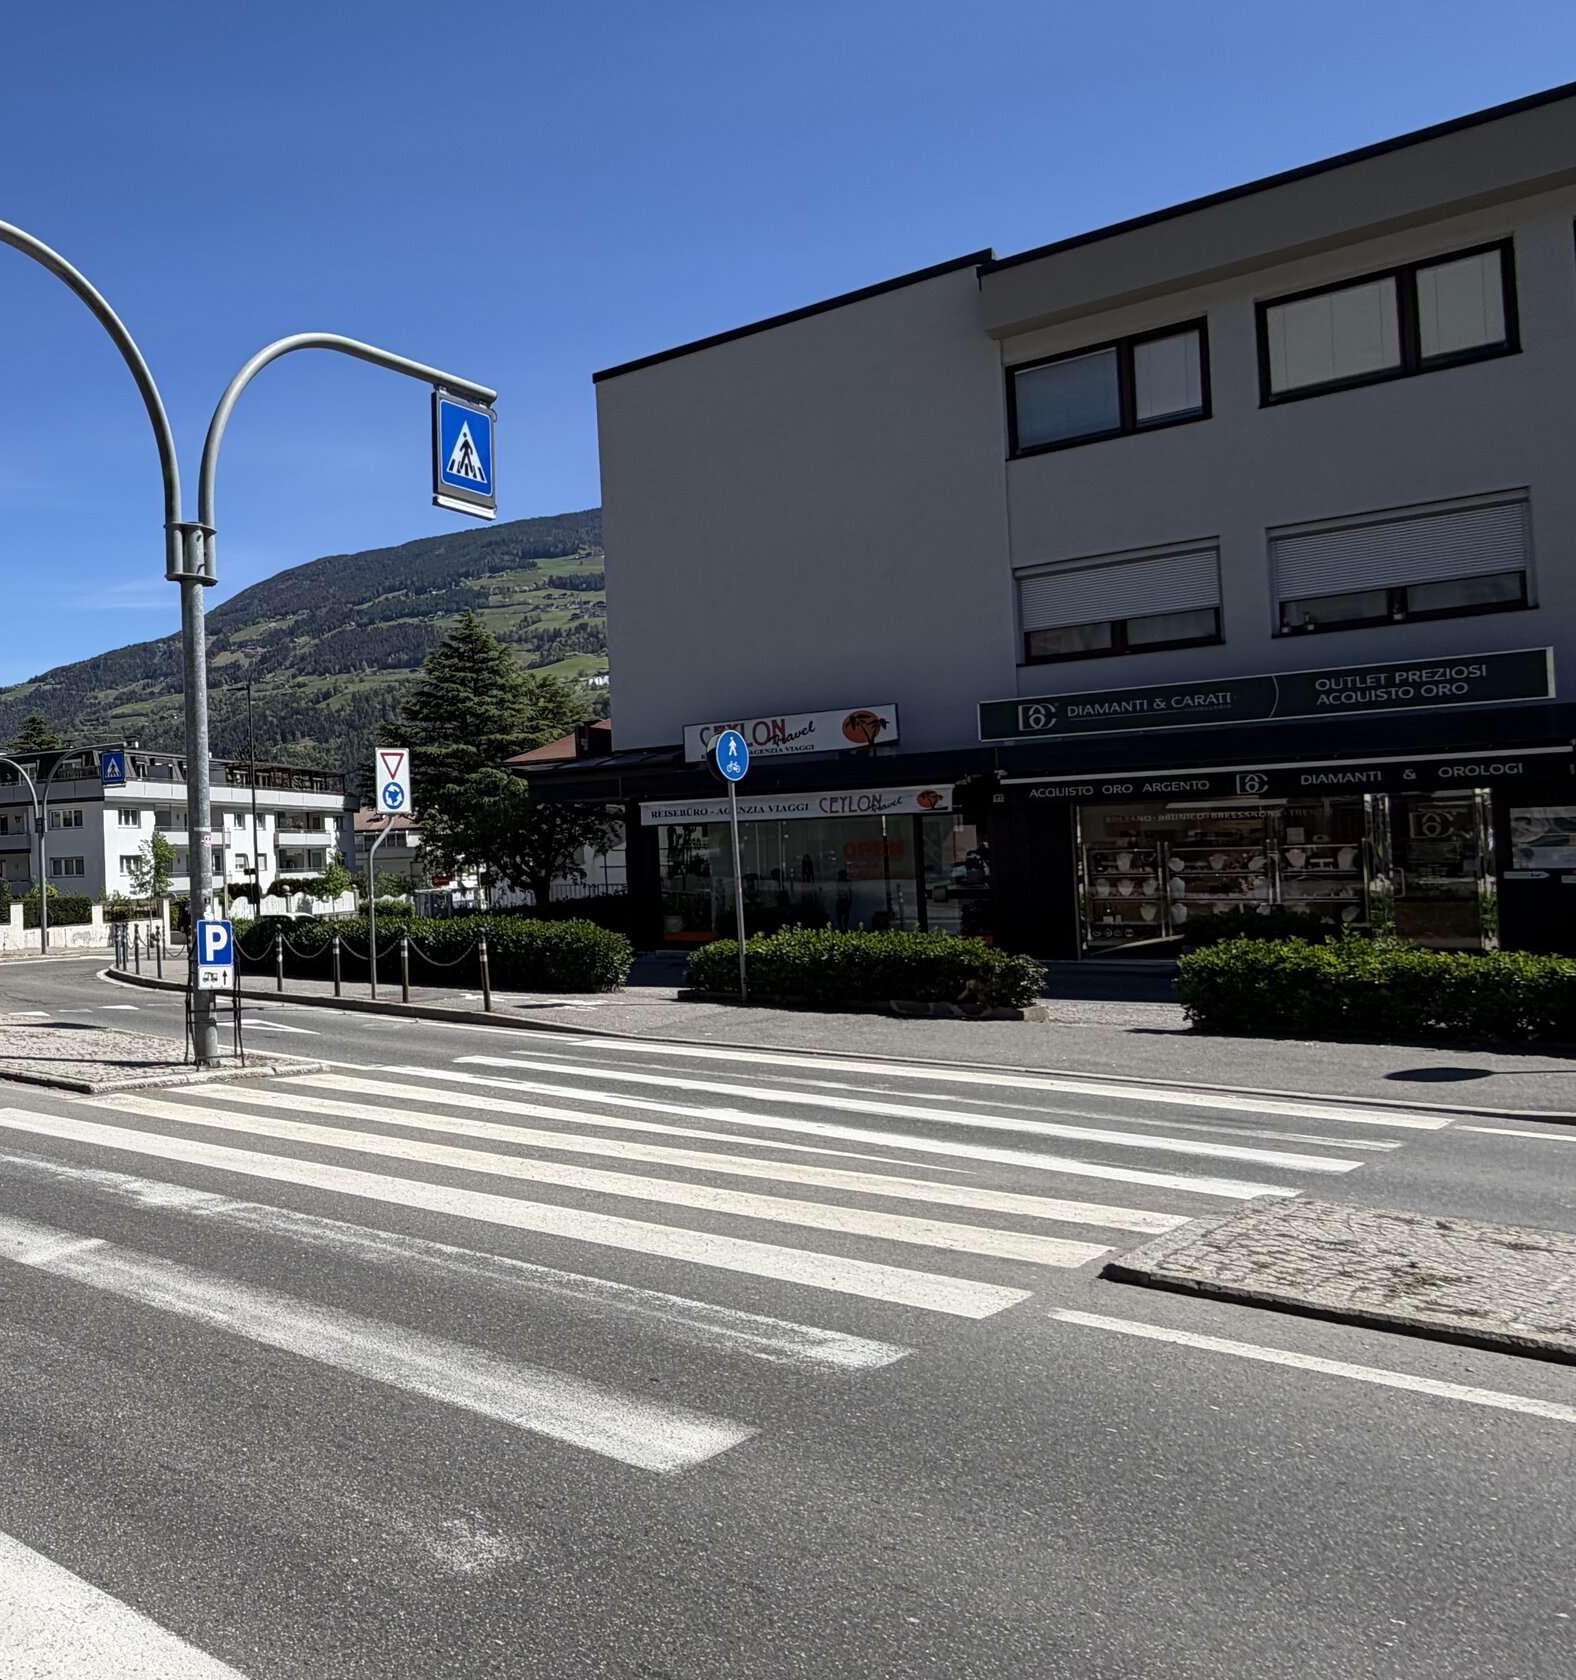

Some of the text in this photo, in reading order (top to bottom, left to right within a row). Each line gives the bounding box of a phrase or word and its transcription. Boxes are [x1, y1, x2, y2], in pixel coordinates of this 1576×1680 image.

[1315, 664, 1487, 691] OUTLET PREZIOSI
[1067, 692, 1231, 718] DIAMANTI & CARATI
[1316, 681, 1469, 706] ACQUISTO ORO
[700, 718, 786, 748] CLON
[785, 744, 815, 753] VIAGGI
[1300, 762, 1524, 786] DIAMANTI & OROLOGI
[1028, 779, 1210, 799] ACQUISTO ORO ARGENTO
[651, 806, 709, 819] REISEBÜRO
[715, 804, 765, 816] AGNZIA
[769, 802, 810, 813] VIAGGI
[819, 793, 883, 814] CEYLON
[205, 924, 228, 962] P
